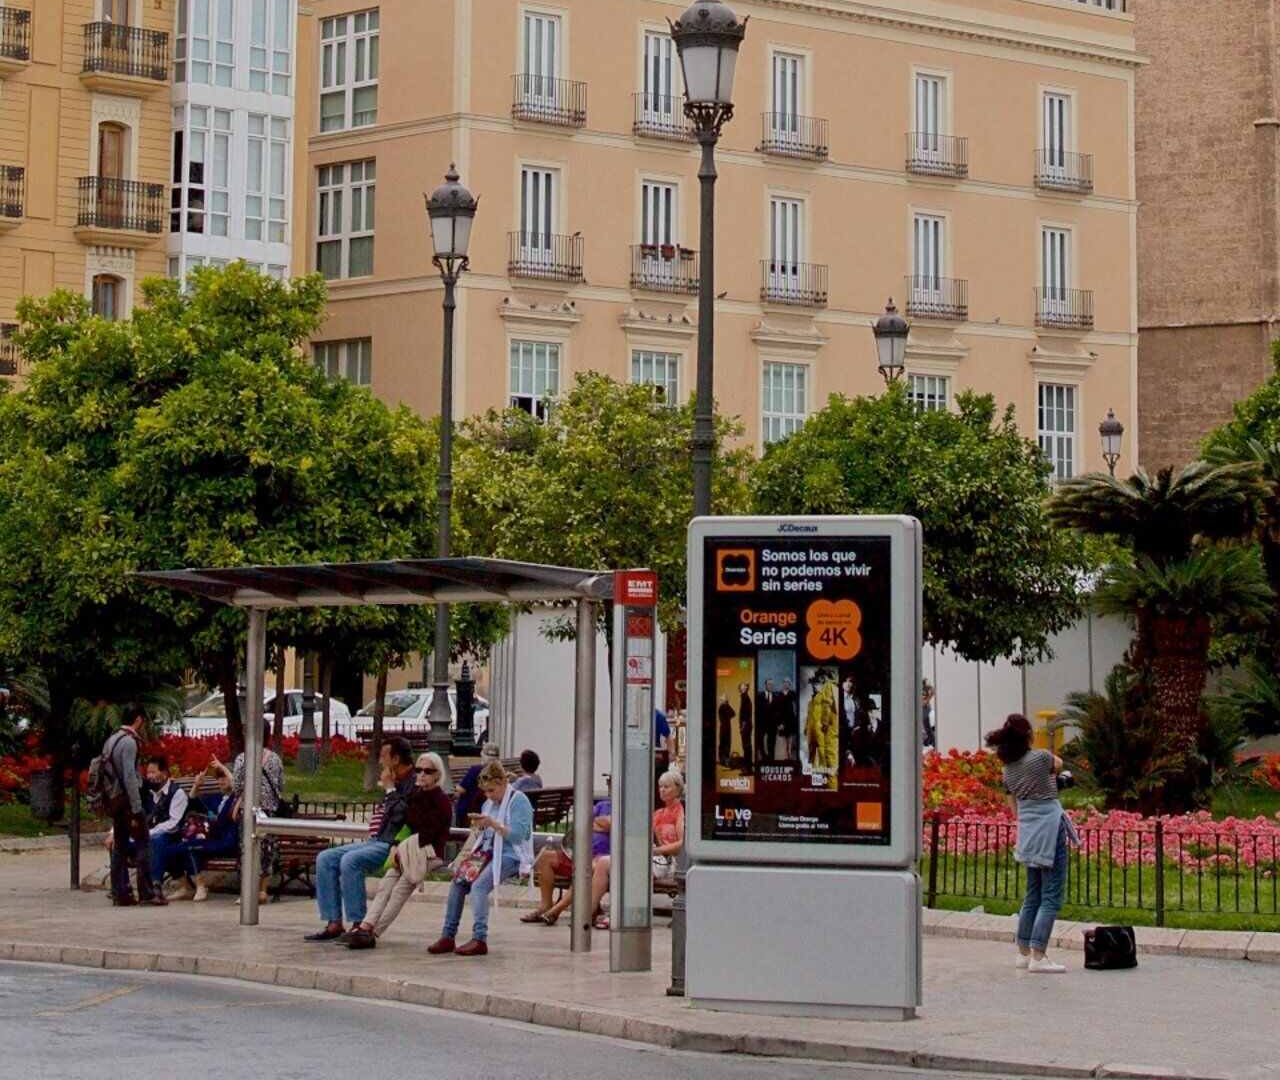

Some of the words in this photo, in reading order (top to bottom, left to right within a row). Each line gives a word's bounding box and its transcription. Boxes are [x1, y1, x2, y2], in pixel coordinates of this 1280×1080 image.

[777, 523, 818, 533] JCDecaux
[762, 549, 806, 562] Somos
[809, 549, 828, 562] los
[832, 552, 856, 564] que
[762, 568, 778, 576] no
[781, 564, 841, 578] podemos
[844, 563, 871, 576] vivir
[627, 580, 653, 588] EMT
[762, 579, 780, 591] sin
[783, 579, 823, 591] series
[740, 609, 797, 626] Orange
[740, 627, 797, 645] Series
[819, 627, 848, 646] 4K
